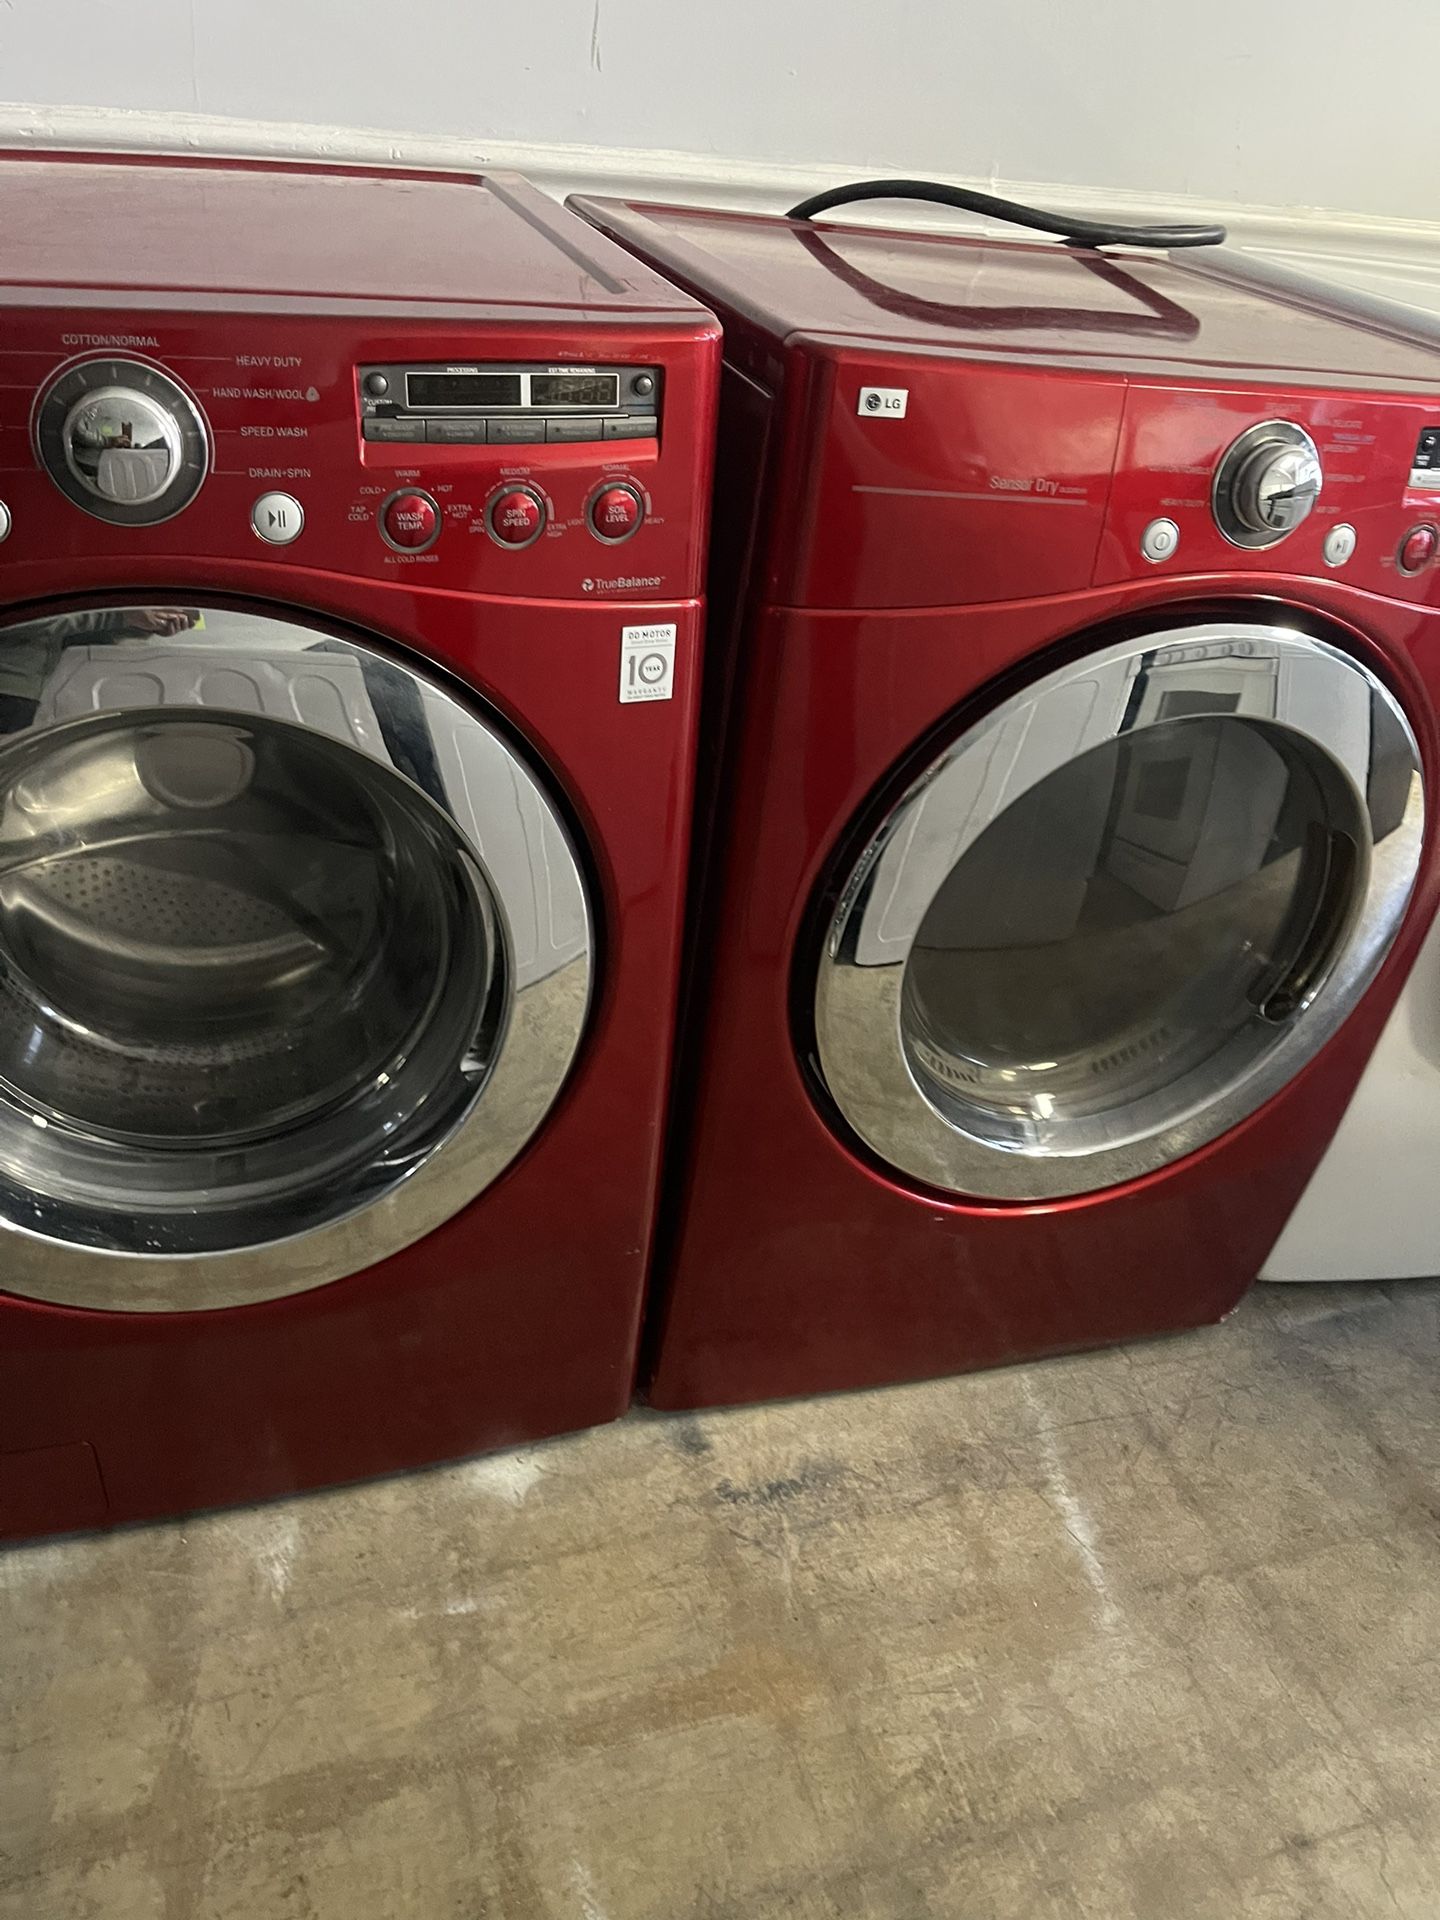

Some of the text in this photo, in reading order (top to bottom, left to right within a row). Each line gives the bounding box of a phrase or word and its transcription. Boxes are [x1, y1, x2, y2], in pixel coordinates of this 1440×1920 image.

[62, 334, 160, 348] COTTON/NORMAL
[236, 355, 302, 368] HEAVY DUTY
[213, 387, 305, 400] HAND WASH/WOOL
[884, 398, 901, 410] LG
[240, 426, 308, 437] SPEED WASH
[394, 470, 421, 478] WARM
[500, 467, 531, 475] MEDIUM
[359, 486, 381, 494] COLD
[437, 484, 453, 492] HOT
[989, 475, 1034, 491] Sensor
[1034, 478, 1060, 496] Dry
[447, 504, 473, 512] EXTRA
[608, 505, 626, 514] SOIL
[348, 513, 369, 521] COLD
[396, 512, 424, 522] WASH
[452, 511, 468, 519] HOT
[506, 509, 526, 518] SPIN
[471, 518, 483, 526] NO
[503, 518, 531, 527] SPEED
[605, 514, 629, 523] LEVEL
[383, 556, 397, 564] ALL
[397, 555, 416, 564] COLD
[642, 629, 671, 639] MOTOR
[628, 652, 668, 686] 10
